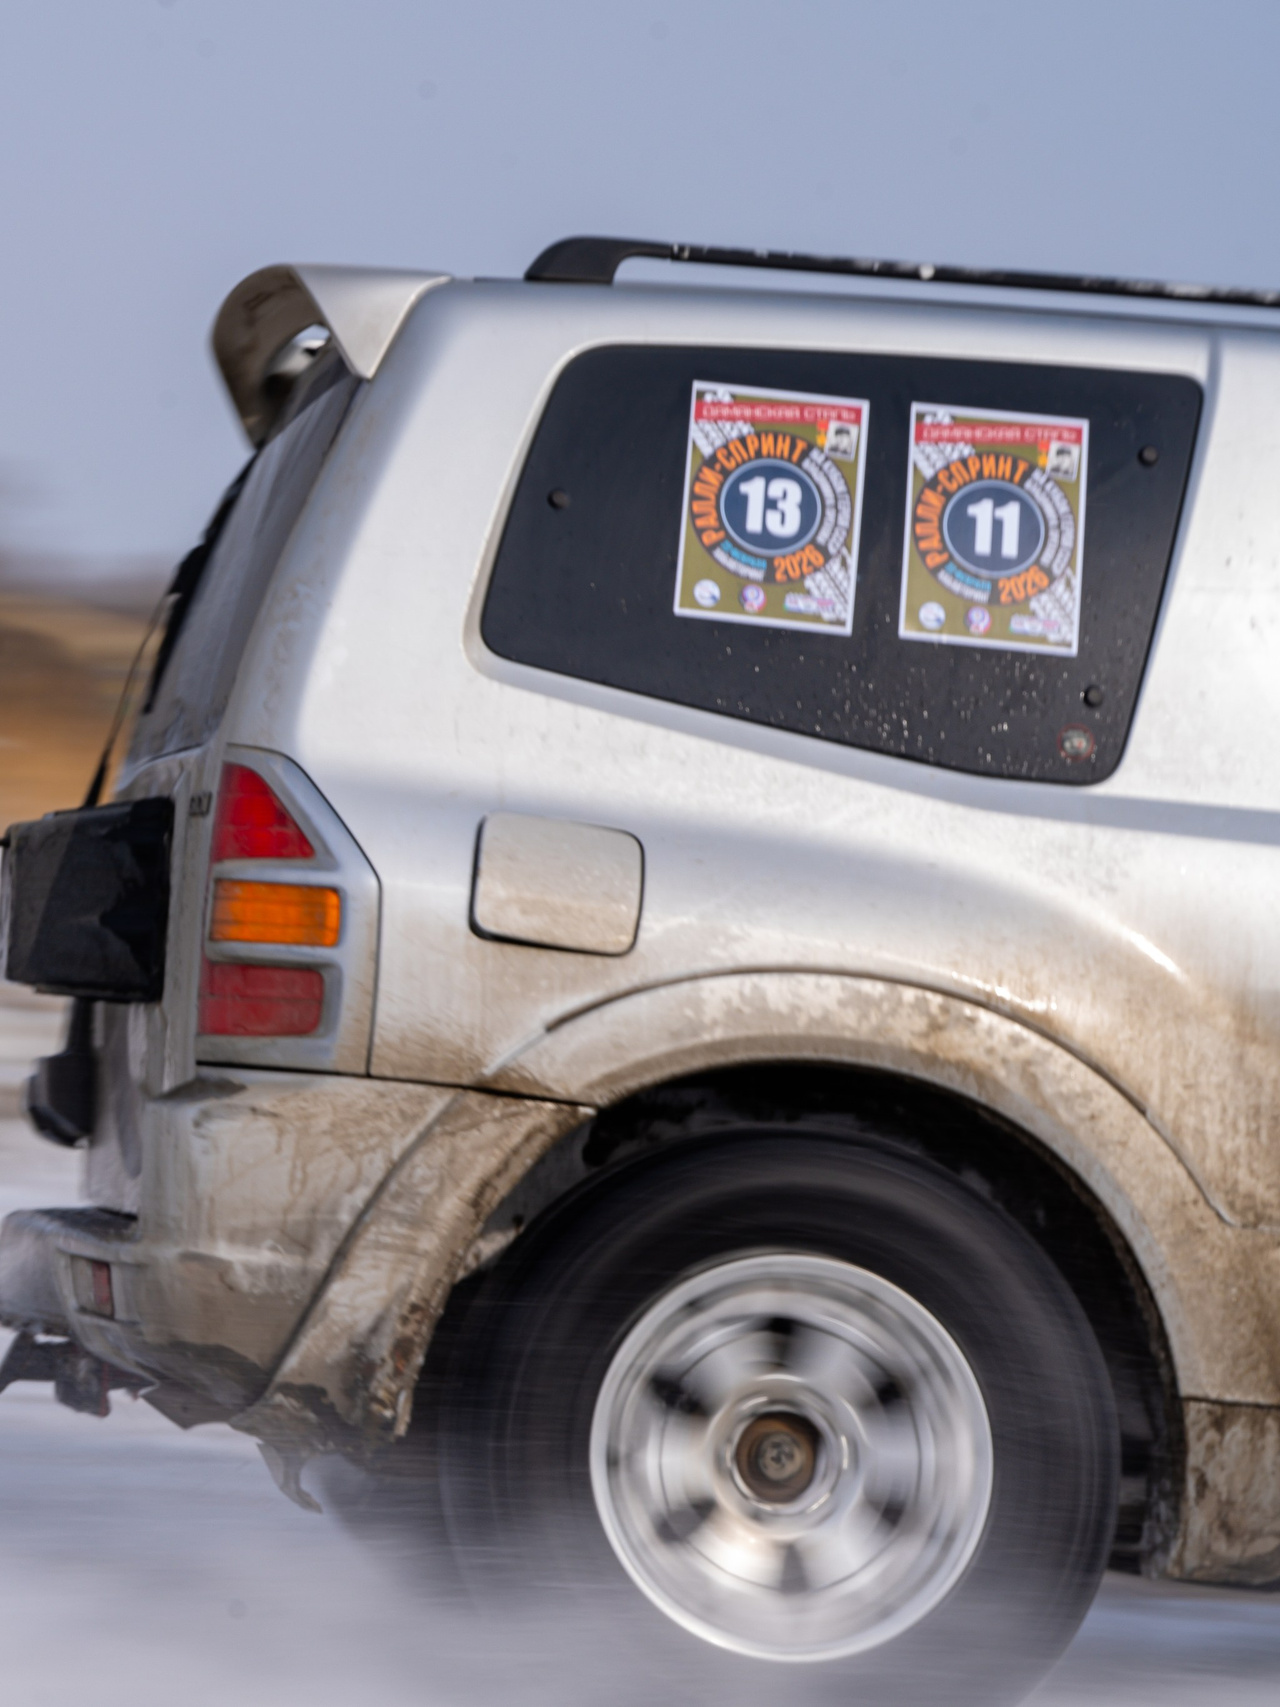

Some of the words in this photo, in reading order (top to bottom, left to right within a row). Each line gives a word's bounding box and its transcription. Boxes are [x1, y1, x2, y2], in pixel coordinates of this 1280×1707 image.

[692, 432, 808, 546] РАЛЛИ-СПРИНТ
[739, 475, 802, 538] 13
[915, 453, 1028, 569] РАЛЛИ-СПРИНТ
[967, 498, 1021, 559] 11
[773, 544, 824, 582] 2026
[998, 565, 1049, 604] 2026
